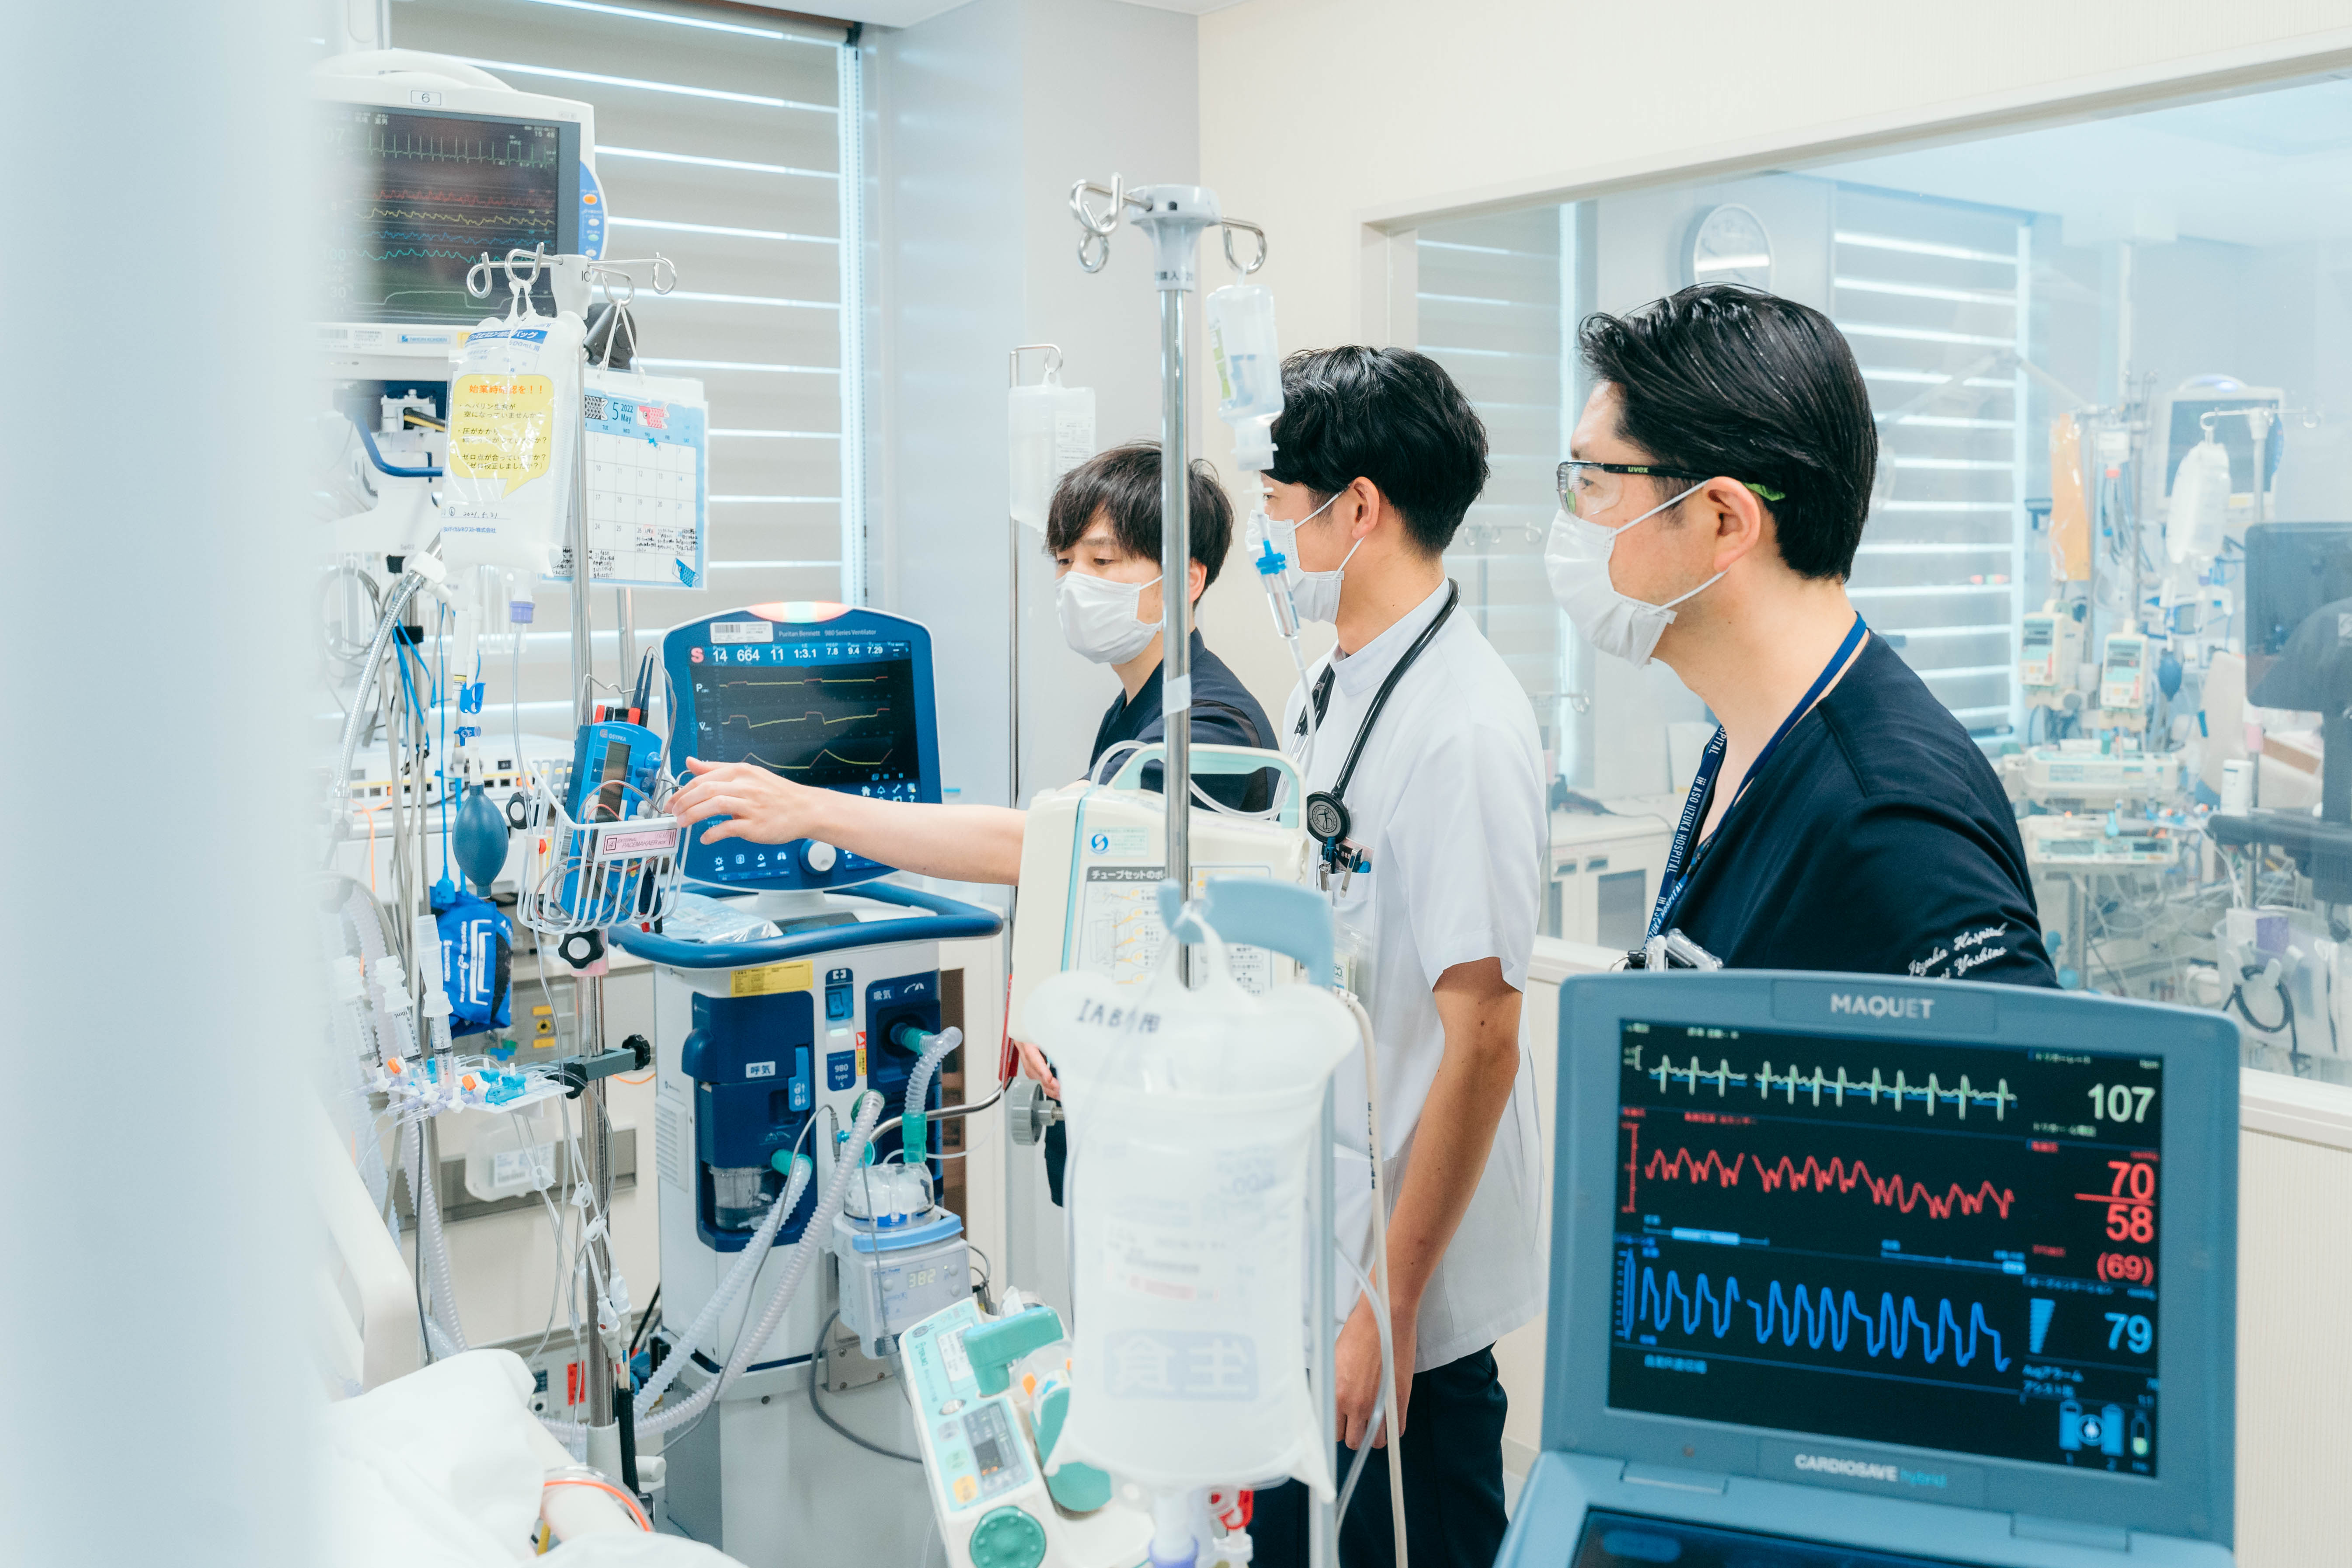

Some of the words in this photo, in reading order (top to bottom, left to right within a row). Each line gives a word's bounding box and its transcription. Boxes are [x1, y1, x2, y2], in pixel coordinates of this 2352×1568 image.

[421, 93, 430, 103] 6
[612, 402, 619, 420] 5
[621, 403, 633, 413] 2022
[621, 413, 632, 424] May
[1628, 466, 1649, 474] uvex
[691, 647, 704, 663] S
[713, 650, 728, 662] 14
[737, 649, 760, 662] 664
[770, 648, 784, 661] 11
[794, 648, 817, 658] 1:3.1
[1688, 786, 1703, 803] ASO
[1679, 804, 1697, 832] IIZUKA
[1666, 833, 1687, 874] HOSPITAL
[1660, 882, 1683, 918] HOSPITAL
[1830, 993, 1934, 1019] MAQUET
[834, 1064, 849, 1073] 980
[835, 1073, 849, 1081] type
[2088, 1082, 2156, 1123] 107
[2107, 1160, 2156, 1200] 70
[2105, 1203, 2154, 1244] 58
[2097, 1252, 2155, 1287] (69)
[2105, 1312, 2153, 1354] 79
[1794, 1453, 1898, 1482] CARDIOSAVE
[1900, 1467, 1947, 1488] hybrid
